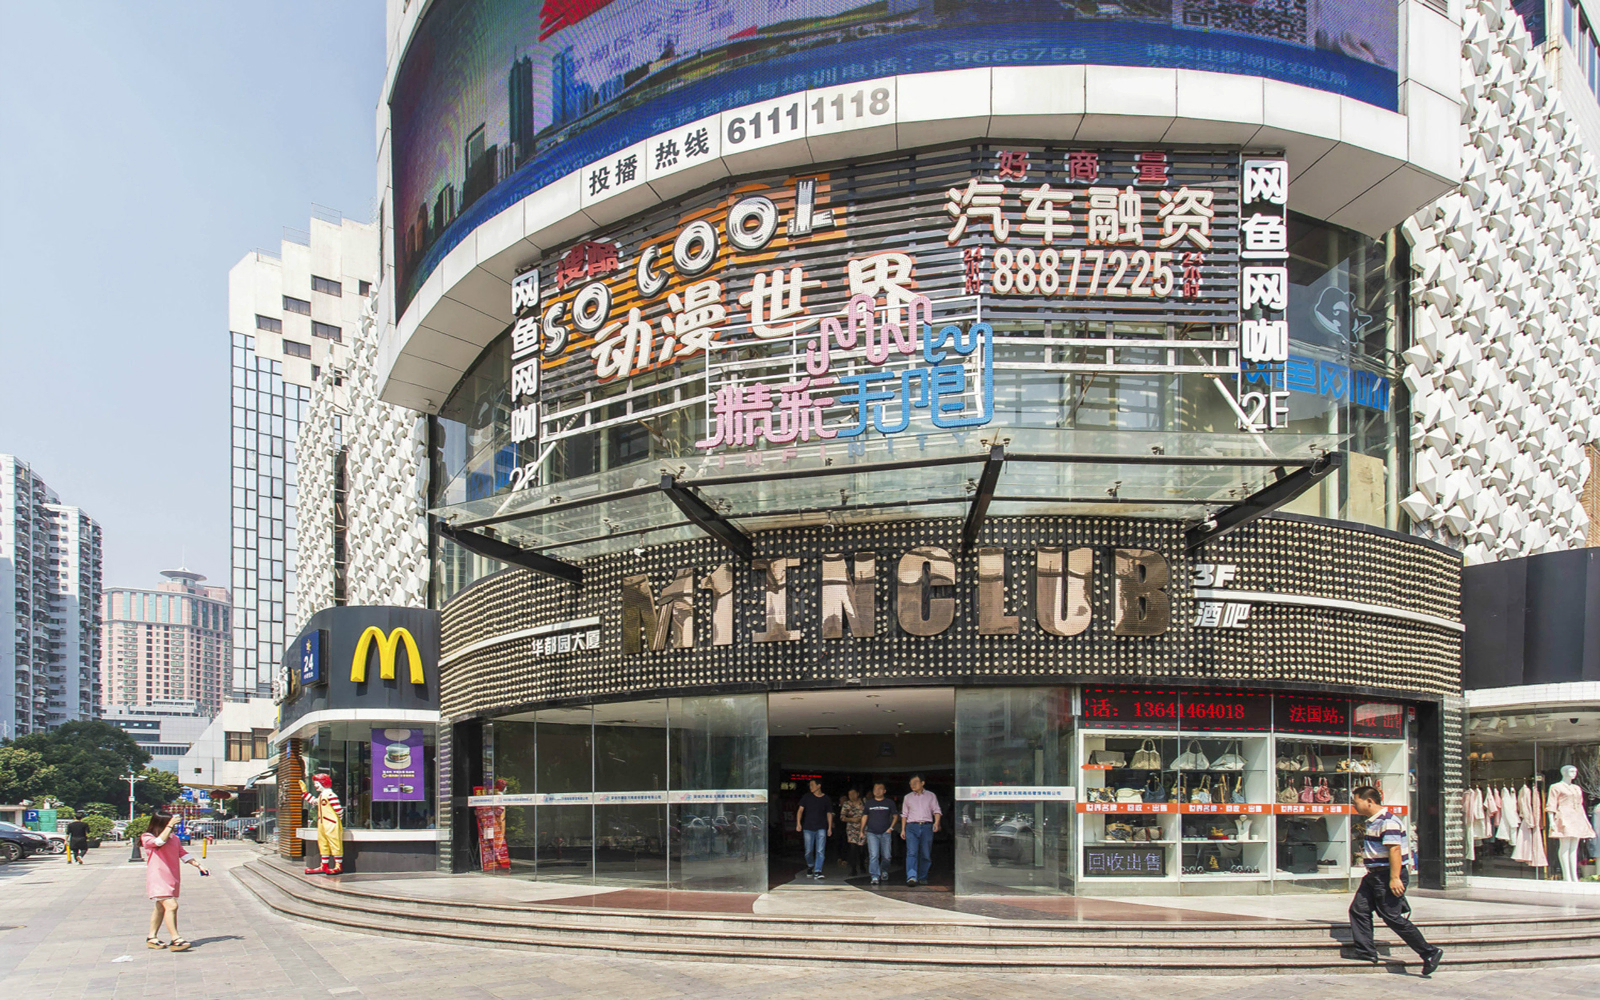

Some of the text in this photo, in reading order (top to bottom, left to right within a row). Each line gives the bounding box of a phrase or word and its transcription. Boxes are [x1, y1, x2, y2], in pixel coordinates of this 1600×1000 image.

[727, 88, 890, 145] 61111118
[1000, 150, 1169, 184] 好商量
[947, 181, 1215, 251] 汽车融资
[635, 178, 837, 299] COOL
[992, 247, 1174, 299] 88877225
[1242, 160, 1289, 363] 网鱼网咖
[591, 252, 920, 380] 动漫世界
[511, 268, 541, 443] 网鱼网咖
[1242, 391, 1290, 432] 2F
[1193, 564, 1237, 588] 3F
[1193, 601, 1252, 629] 酒吧
[531, 629, 601, 657] 华都园大厦
[303, 653, 315, 673] 24
[1134, 702, 1245, 719] 13641464018
[27, 811, 37, 820] P
[1089, 852, 1161, 871] 回收出售
